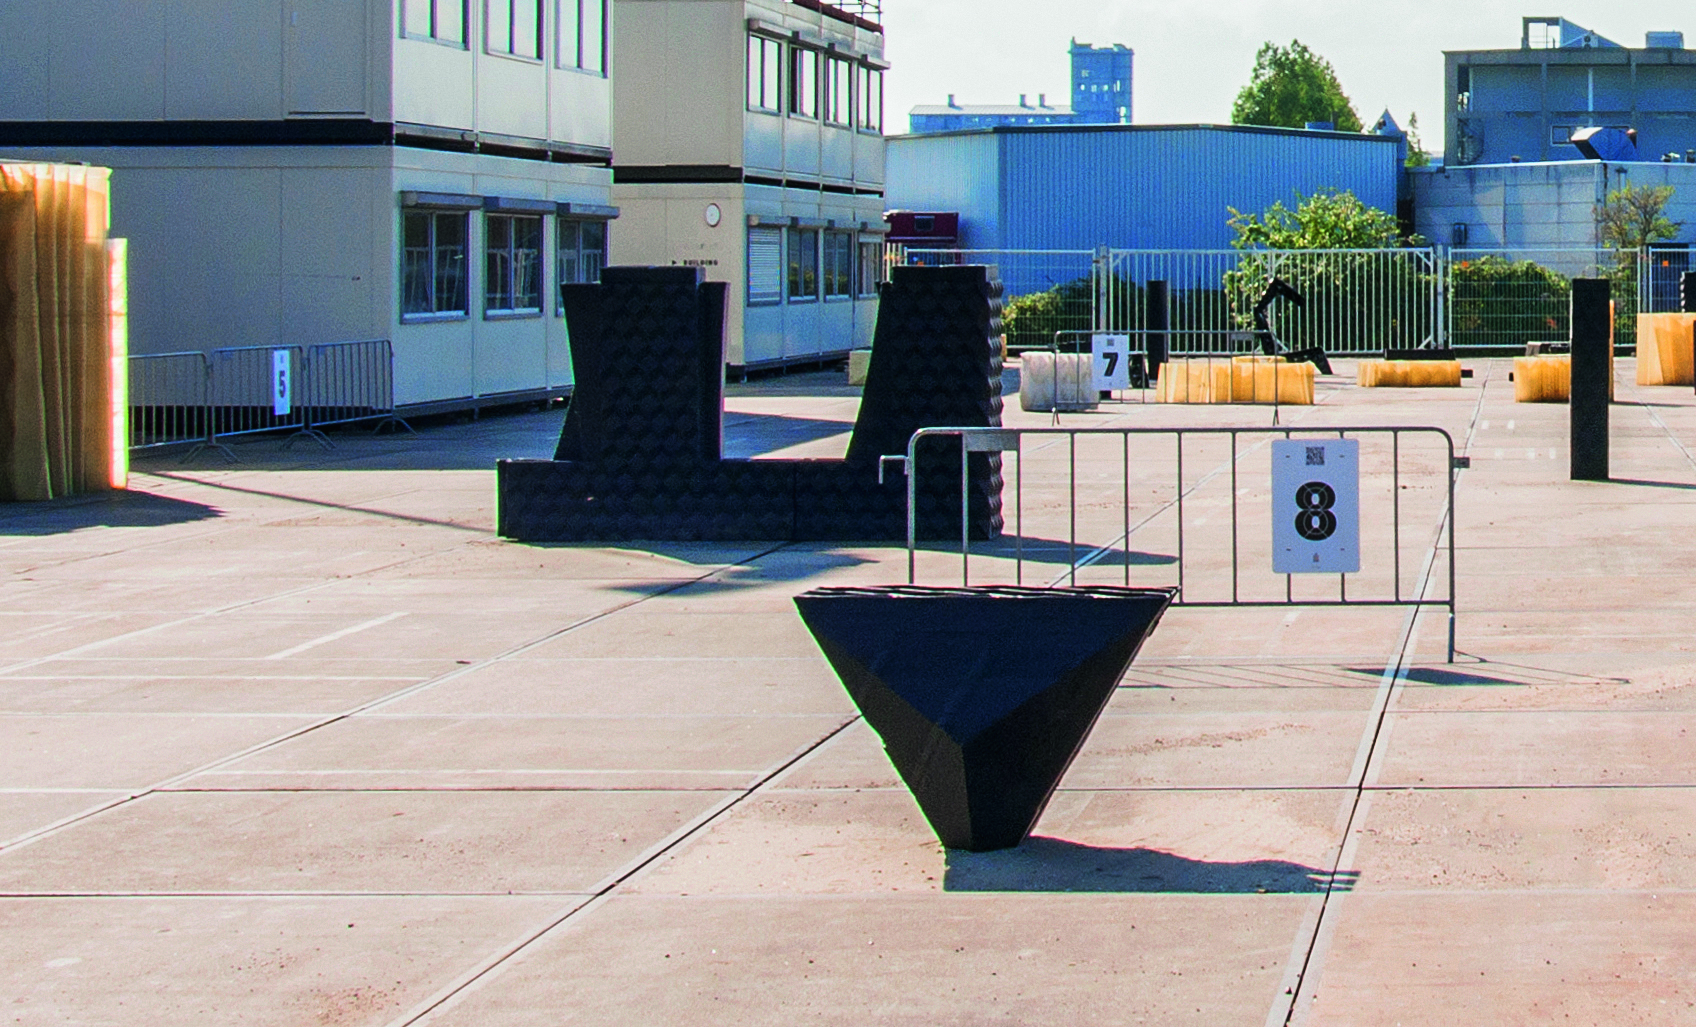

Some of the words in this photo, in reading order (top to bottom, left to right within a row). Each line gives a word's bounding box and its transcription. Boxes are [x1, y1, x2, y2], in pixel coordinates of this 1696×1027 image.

[1102, 352, 1118, 377] 7
[279, 370, 286, 398] 5
[1294, 481, 1337, 541] 8
